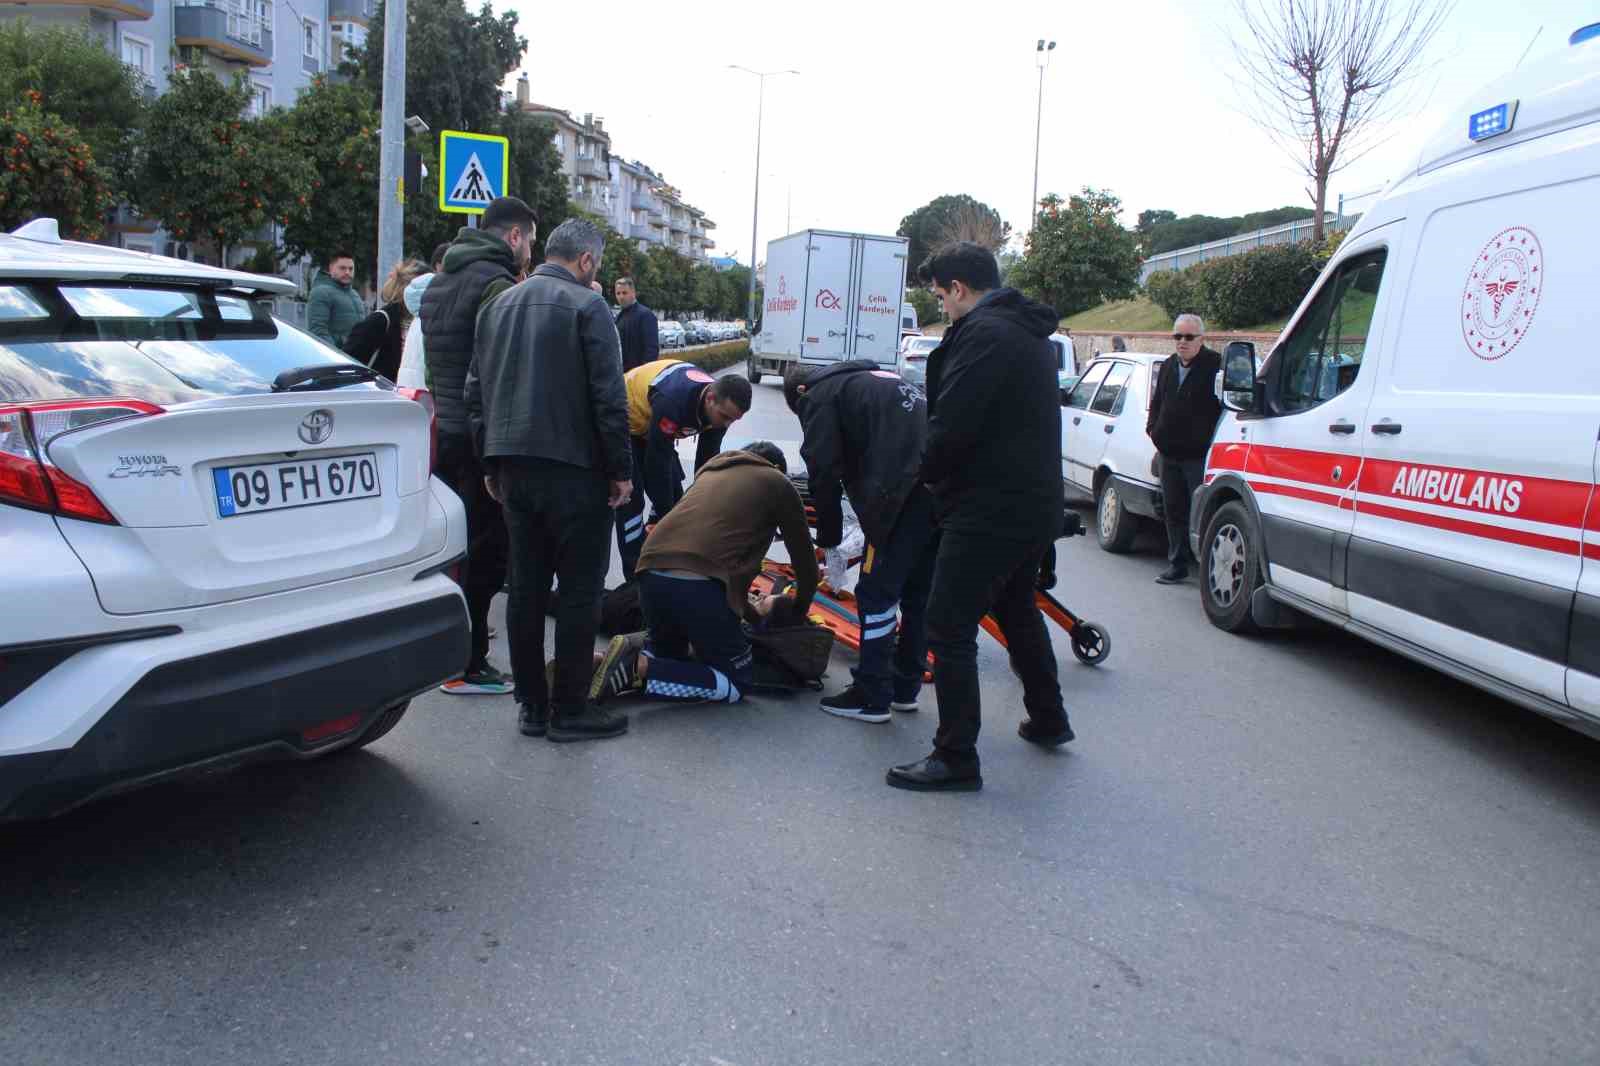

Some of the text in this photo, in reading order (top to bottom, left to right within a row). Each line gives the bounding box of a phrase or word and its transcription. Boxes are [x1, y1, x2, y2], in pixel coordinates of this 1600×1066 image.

[118, 455, 168, 466] TOYOTA
[231, 459, 375, 508] 09 FH 670
[1391, 466, 1524, 513] AMBULANS
[219, 495, 233, 507] TR
